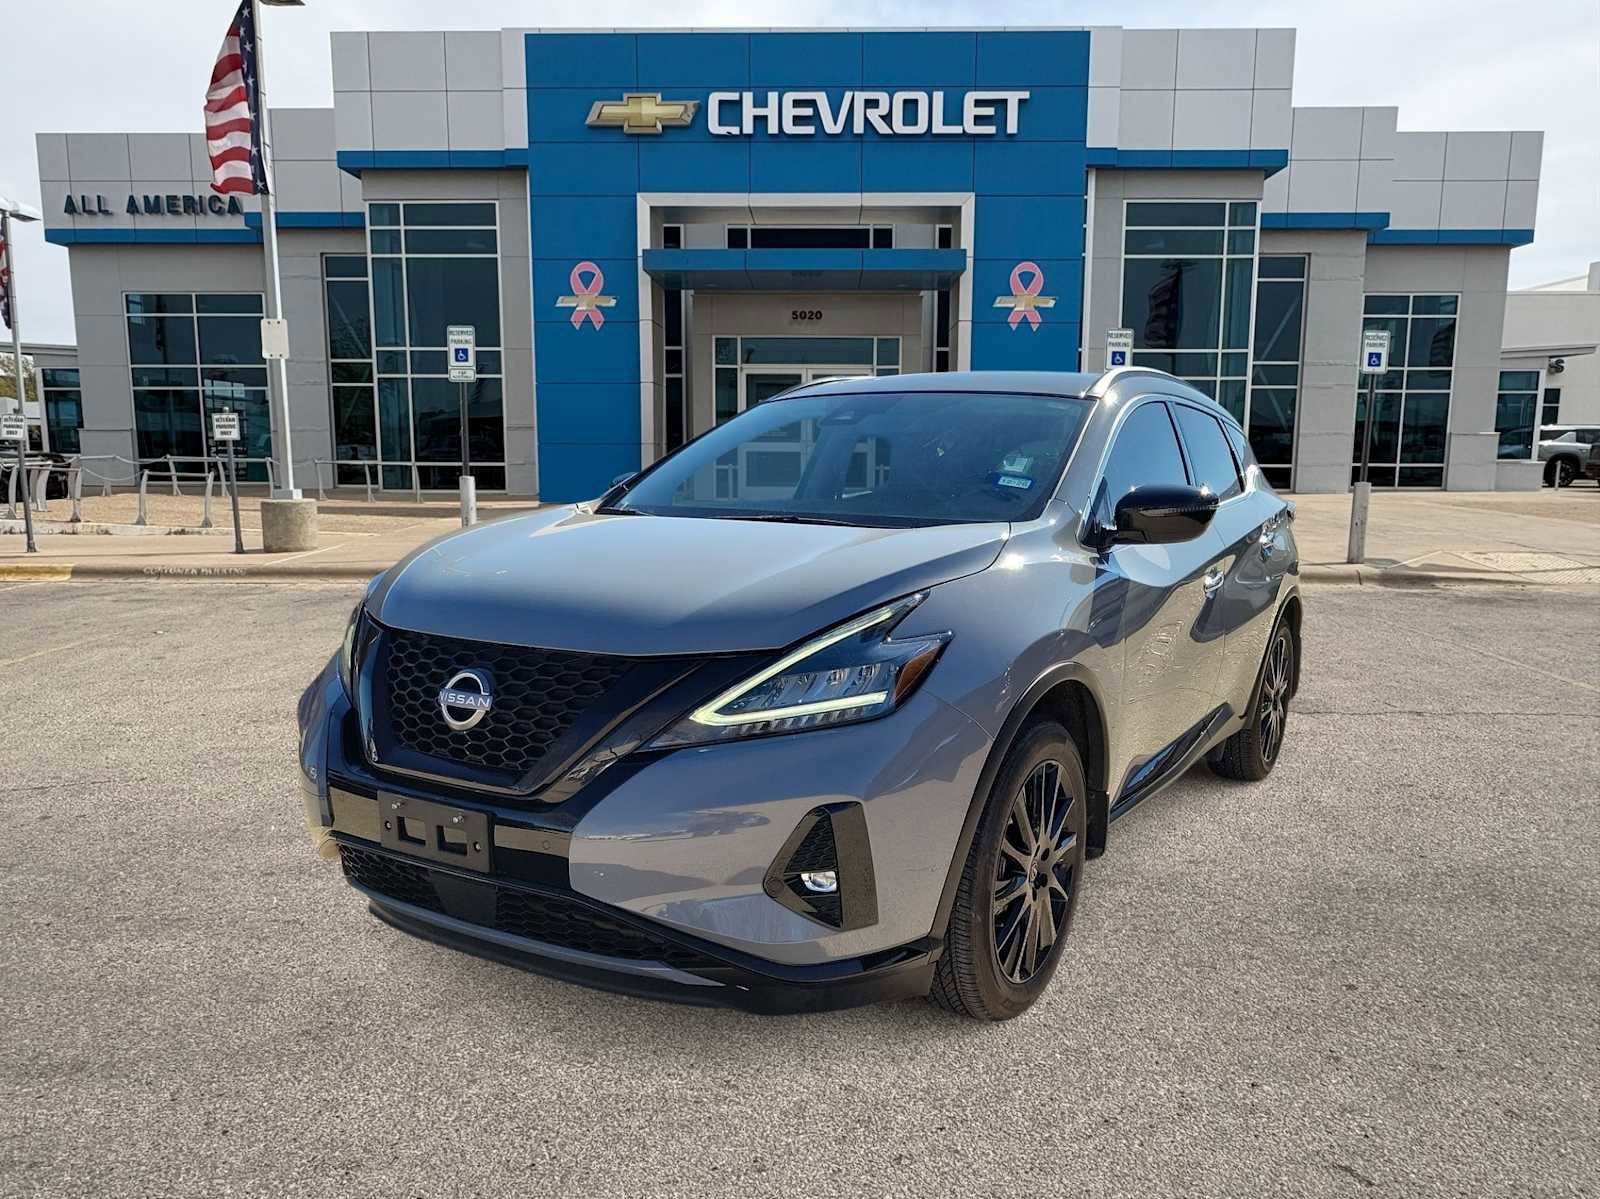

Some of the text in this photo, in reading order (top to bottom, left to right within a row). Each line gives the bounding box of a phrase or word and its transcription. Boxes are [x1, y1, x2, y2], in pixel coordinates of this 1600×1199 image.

[708, 91, 1031, 136] CHEVROLET
[64, 195, 243, 215] ALL AMERICA
[791, 310, 823, 320] 5020
[439, 690, 490, 708] NISSAN
